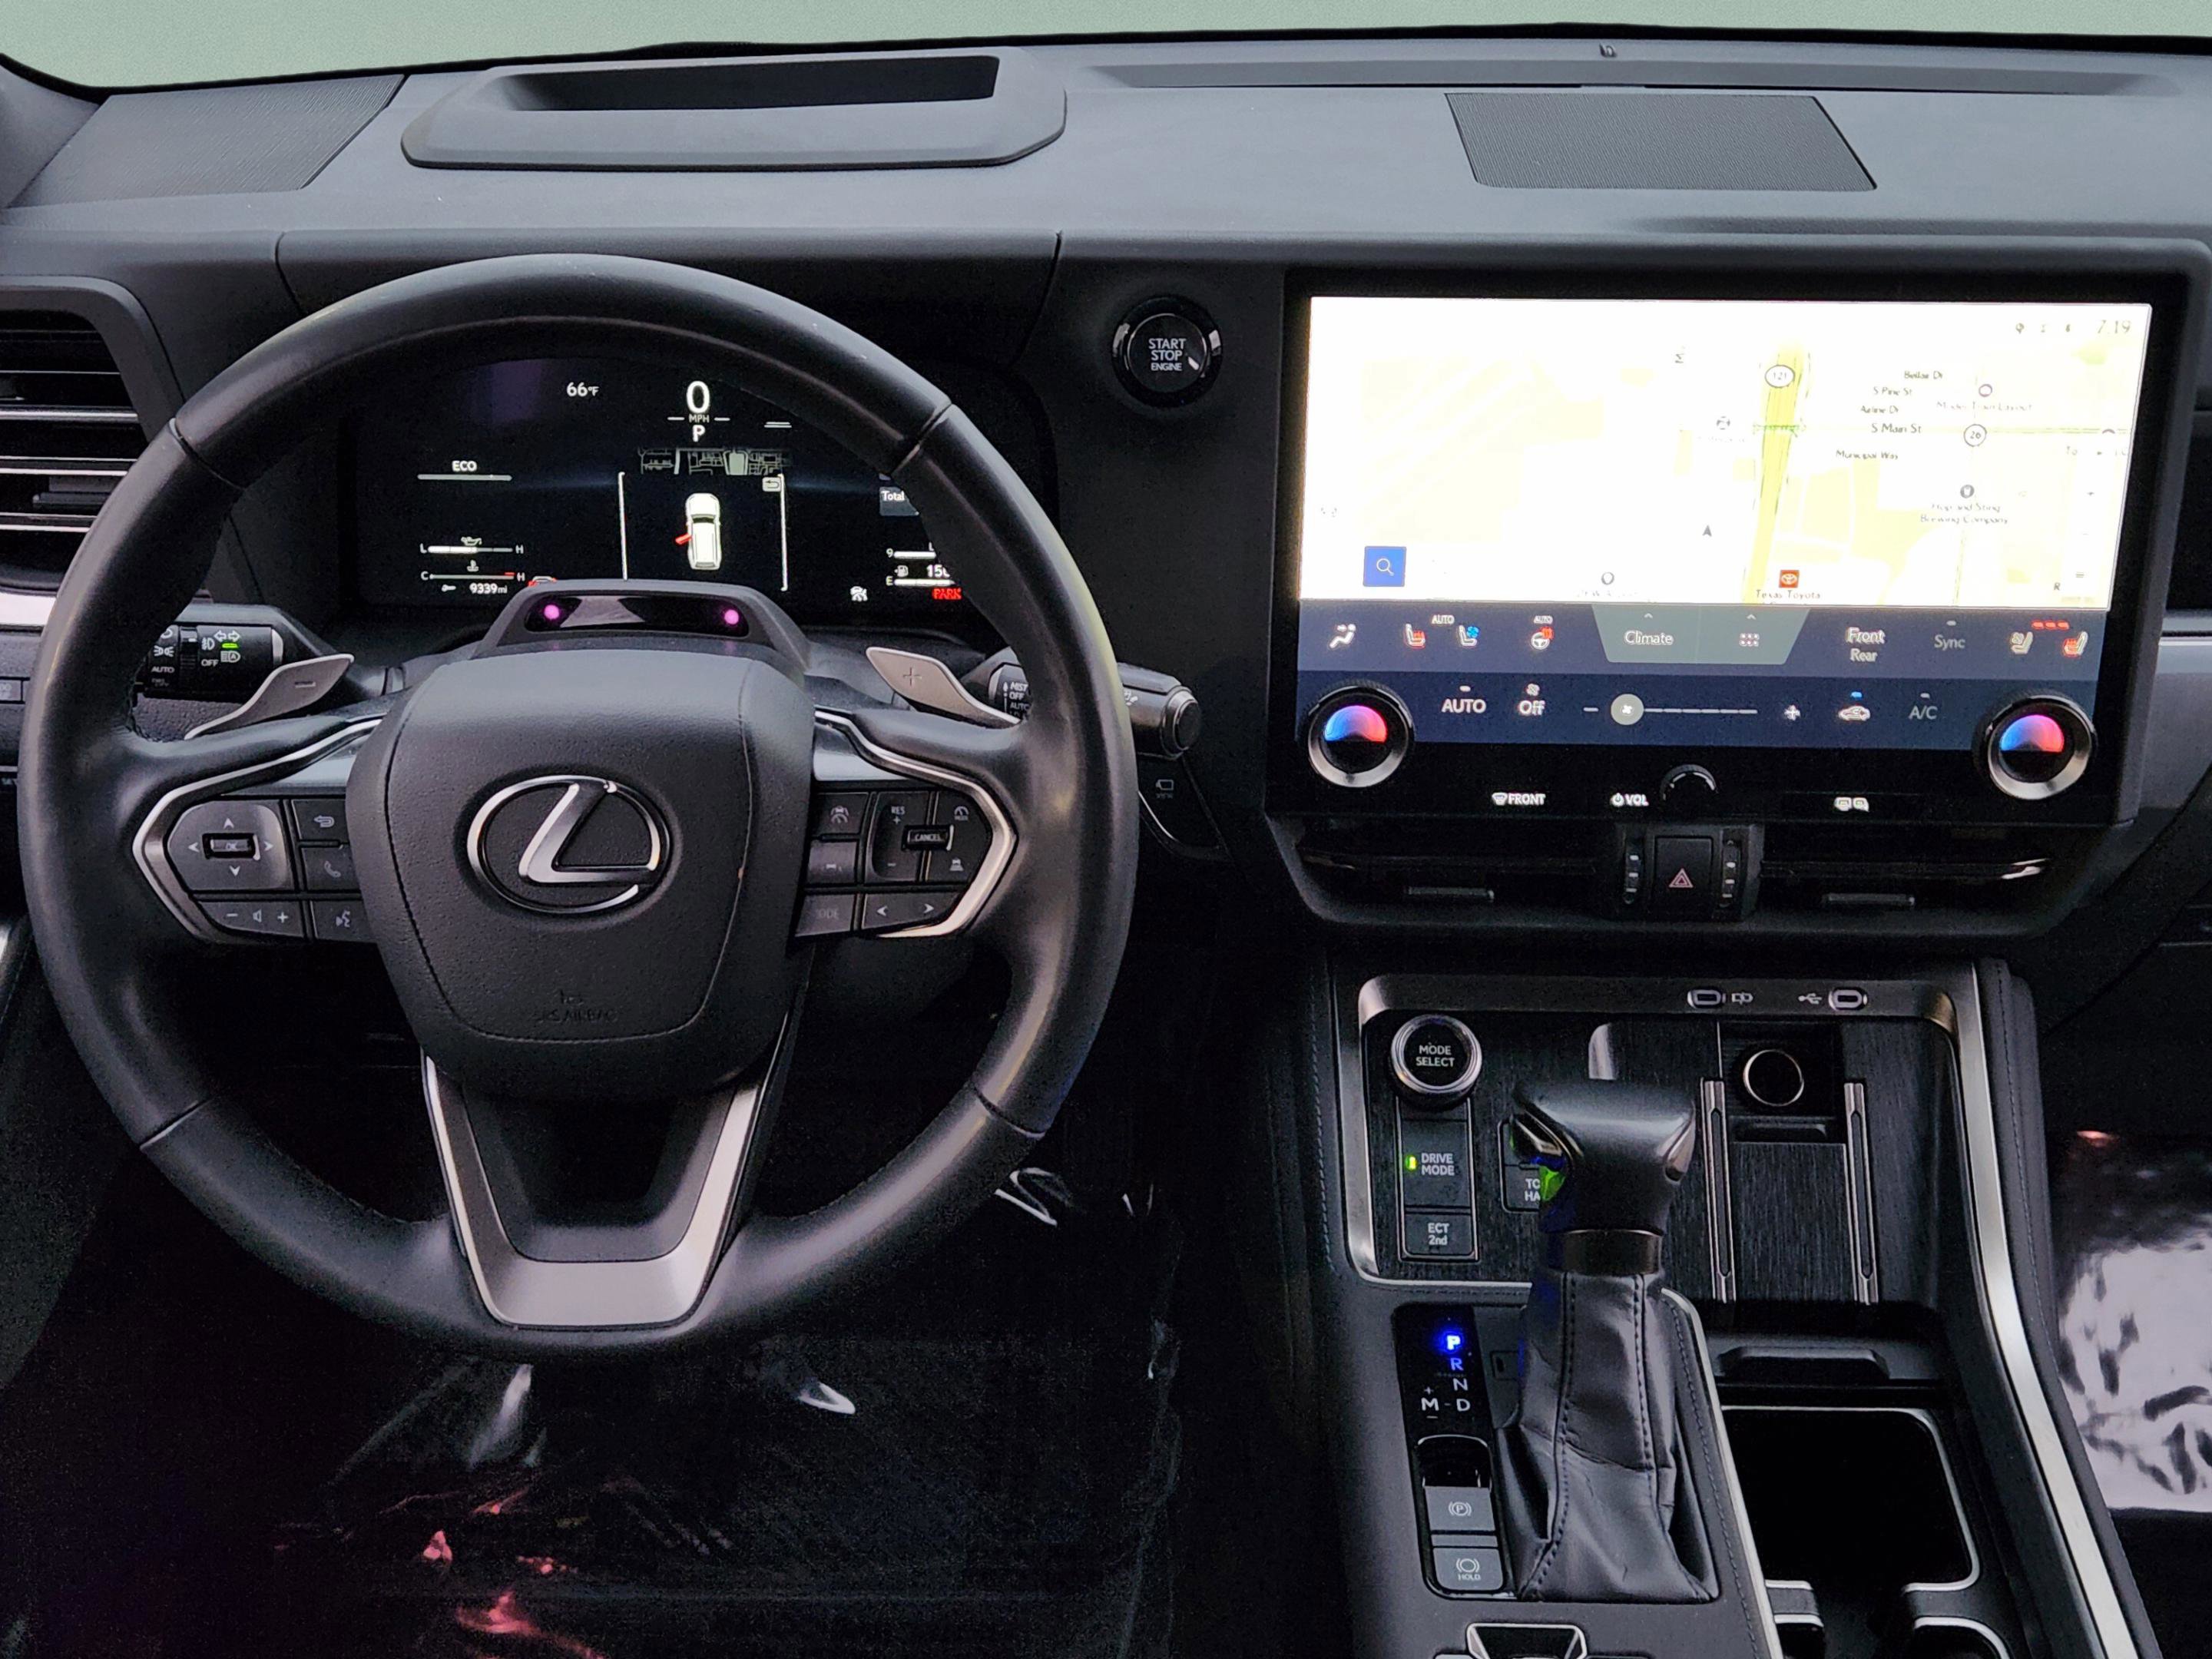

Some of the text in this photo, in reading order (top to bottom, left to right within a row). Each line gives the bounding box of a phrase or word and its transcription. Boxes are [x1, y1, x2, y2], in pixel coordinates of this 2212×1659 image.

[1148, 338, 1187, 349] START
[1151, 350, 1184, 361] STOP
[1151, 362, 1184, 372] ENGINE
[686, 380, 710, 414] 0
[688, 414, 710, 424] MPH
[693, 425, 705, 442] P
[1909, 423, 1922, 435] St
[452, 461, 478, 472] ECO
[881, 490, 906, 502] Total
[421, 572, 428, 581] C
[517, 573, 525, 582] H
[886, 576, 894, 586] E
[932, 587, 962, 600] PARK
[1787, 590, 1821, 601] Toyota
[1432, 614, 1455, 625] AUTO
[1533, 615, 1553, 624] AUTO
[1624, 631, 1674, 646] Climate
[1846, 627, 1886, 645] Front
[1934, 634, 1965, 651] Sync
[1850, 648, 1877, 663] Rear
[201, 658, 218, 667] OFF
[151, 666, 174, 674] AUTO
[1010, 681, 1029, 692] MIST
[1009, 691, 1025, 700] OFF
[1442, 699, 1486, 714] AUTO
[1518, 700, 1545, 717] Off
[1909, 706, 1938, 720] A/C
[1508, 793, 1546, 806] FRONT
[1626, 793, 1649, 807] VOL
[891, 805, 906, 816] RES
[914, 833, 942, 842] CANCEL
[1419, 1045, 1452, 1056] MODE
[1416, 1055, 1456, 1068] SELECT
[1421, 1153, 1453, 1164] DRIVE
[1421, 1164, 1455, 1177] MODE
[1427, 1223, 1450, 1234] ECT
[1429, 1234, 1448, 1246] 2nd
[1446, 1335, 1461, 1350] P
[1450, 1357, 1463, 1371] R
[1453, 1378, 1469, 1392] N
[1421, 1398, 1472, 1412] M D
[1457, 1573, 1482, 1581] HOLD
